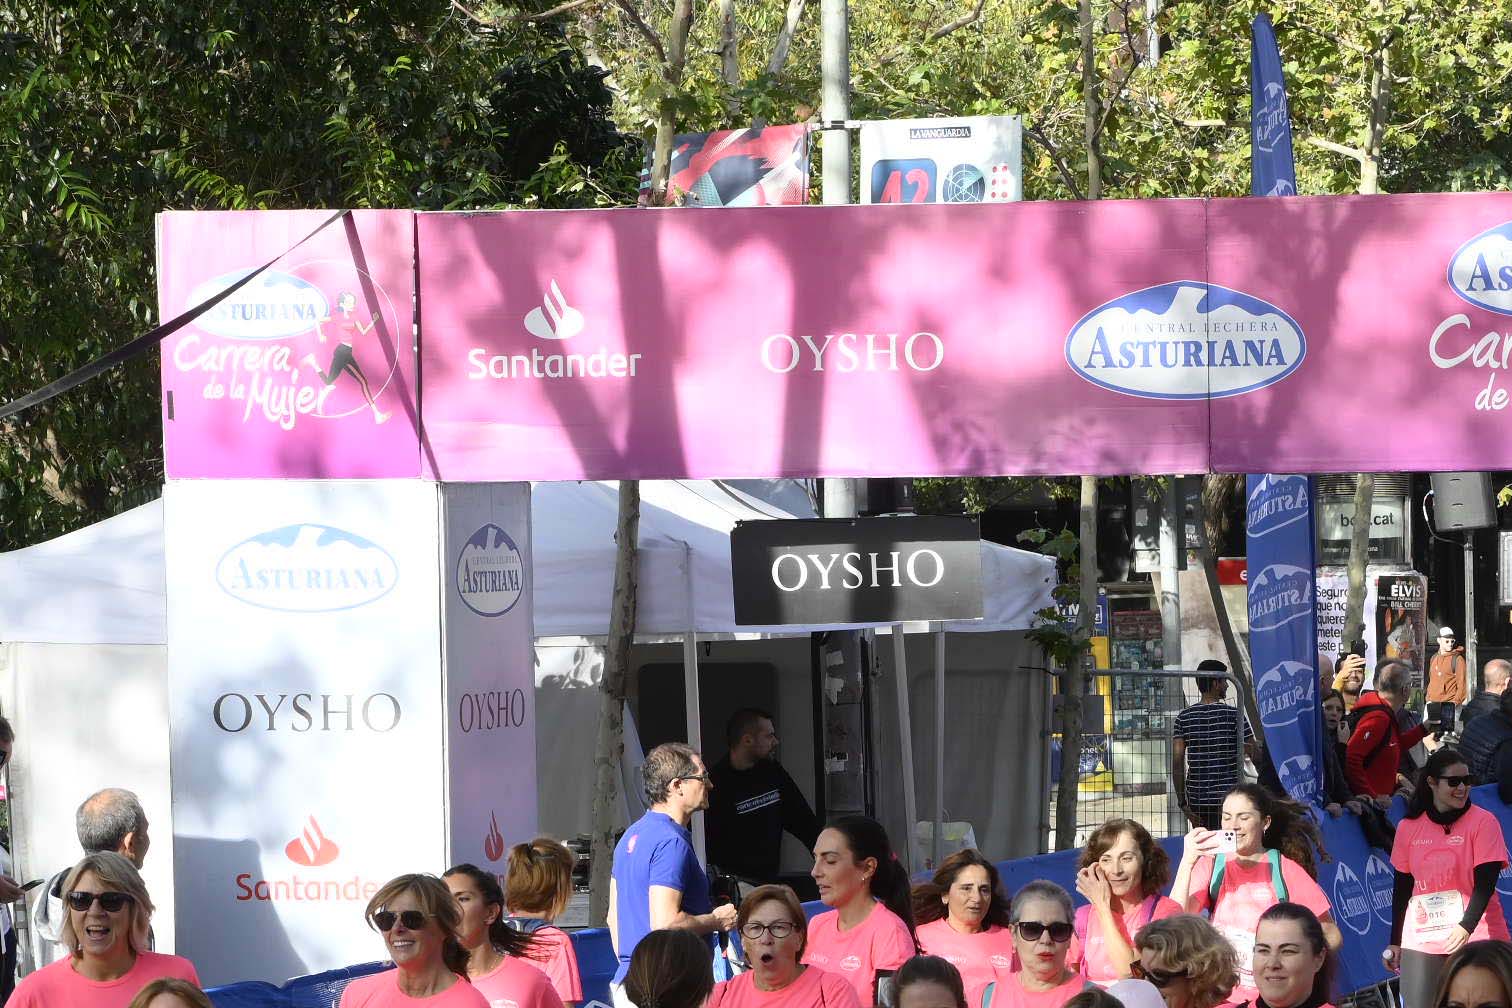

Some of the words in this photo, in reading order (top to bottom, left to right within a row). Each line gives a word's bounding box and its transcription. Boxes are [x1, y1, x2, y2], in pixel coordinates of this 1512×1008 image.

[921, 128, 970, 139] VANGUARDIA
[206, 303, 317, 321] STURIANA
[1204, 321, 1278, 332] LECHERA
[173, 336, 291, 372] Carrera
[467, 348, 641, 380] Santander
[760, 332, 945, 373] OYSHO
[1084, 326, 1288, 368] ASTURIANA
[203, 381, 225, 400] de
[229, 379, 246, 400] la
[243, 372, 337, 430] Mujer
[1475, 372, 1508, 411] de
[231, 558, 387, 590] ASTURIANA
[462, 564, 520, 594] ASTURIANA
[772, 550, 944, 592] OYSHO
[1391, 585, 1421, 596] ELVIS
[213, 692, 402, 732] OYSHO
[459, 688, 525, 733] OYSHO
[235, 873, 381, 901] Santande
